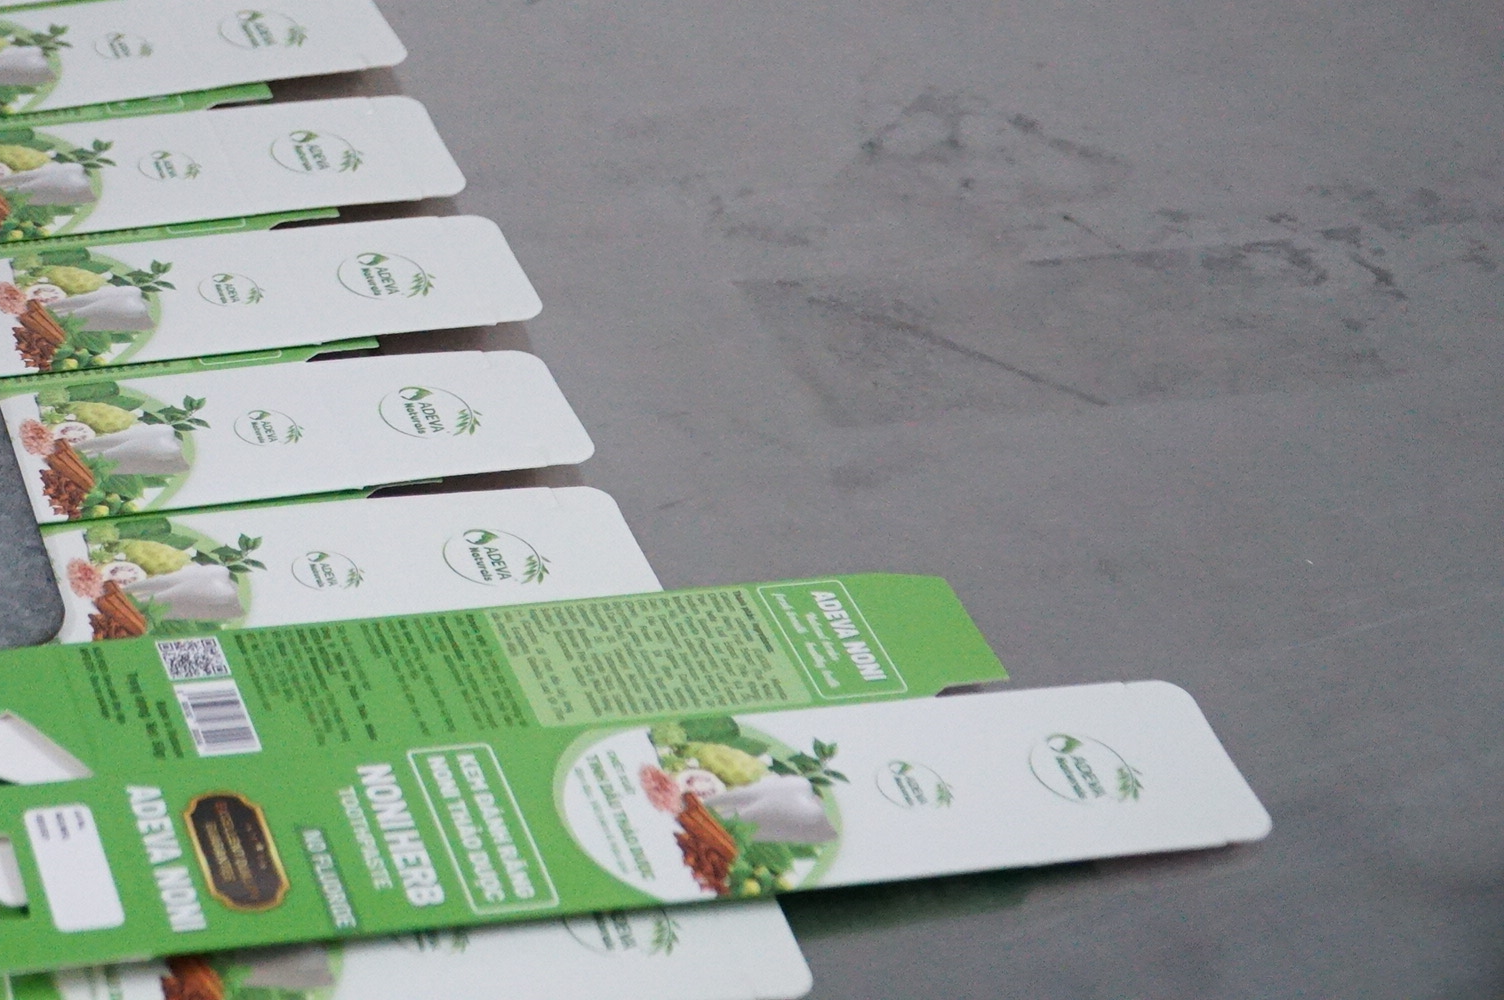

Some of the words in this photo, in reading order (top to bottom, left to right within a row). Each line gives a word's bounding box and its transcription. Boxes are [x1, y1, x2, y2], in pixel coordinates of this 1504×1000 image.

[404, 402, 426, 434] Naturals
[418, 402, 445, 432] ADEVA
[469, 547, 492, 581] Naturals
[484, 546, 512, 580] ADEVA
[810, 590, 860, 639] ADEVA
[842, 641, 887, 681] NONI
[427, 756, 462, 799] NONI
[456, 754, 489, 790] KEM
[126, 785, 183, 865] ADEVA
[302, 829, 327, 853] NO
[338, 785, 393, 891] TOOTHPASTE
[357, 762, 445, 907] NONIHERB
[153, 866, 207, 933] NONI
[311, 853, 357, 929] FLUORIDE
